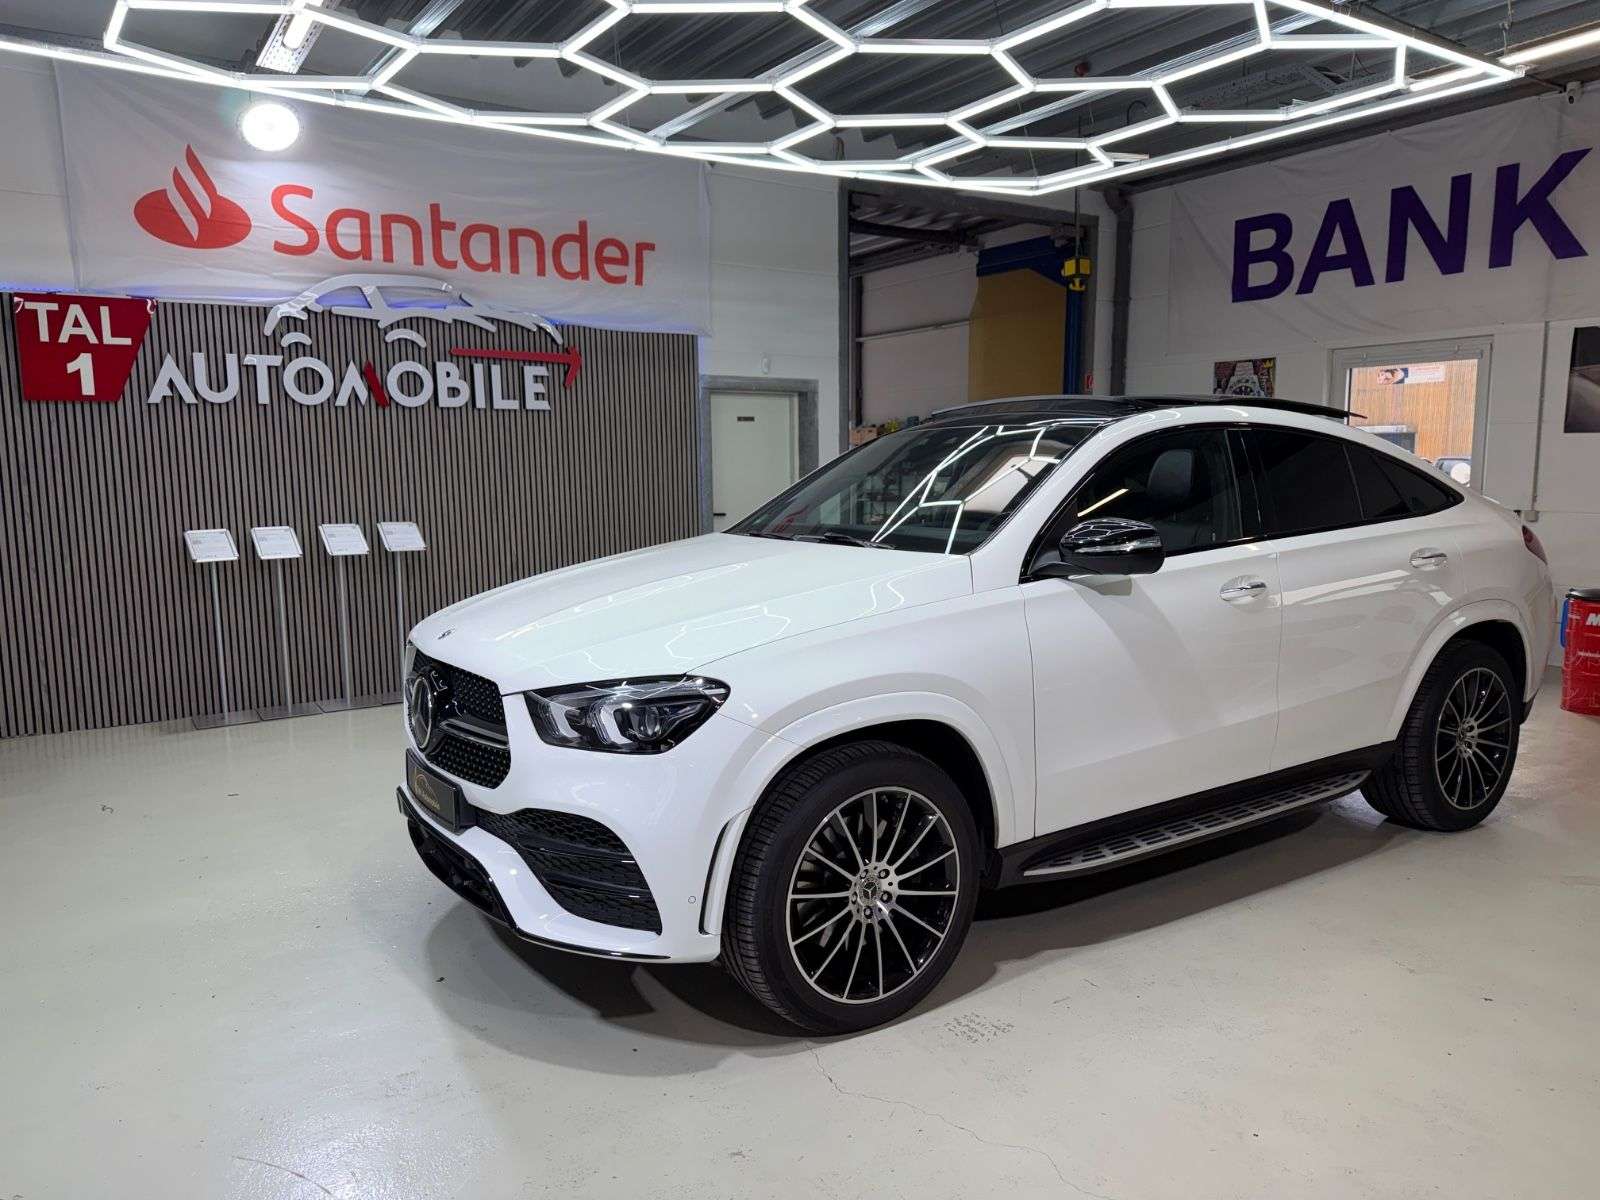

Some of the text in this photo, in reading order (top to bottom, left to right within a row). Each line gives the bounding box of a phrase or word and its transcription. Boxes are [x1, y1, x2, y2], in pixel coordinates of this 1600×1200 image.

[270, 183, 656, 287] Santander
[1231, 147, 1593, 303] BANK
[24, 301, 132, 346] TAL
[66, 352, 96, 396] 1
[147, 352, 552, 411] AUTOMOBILE
